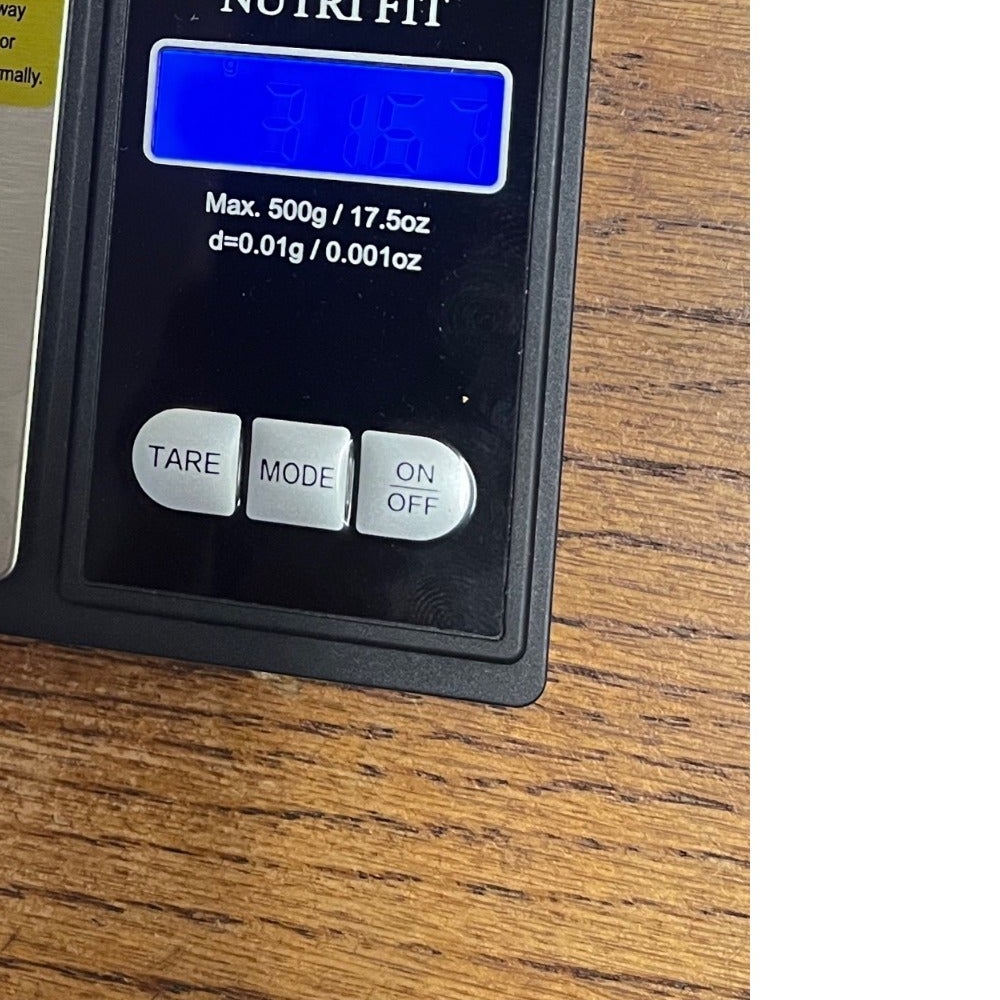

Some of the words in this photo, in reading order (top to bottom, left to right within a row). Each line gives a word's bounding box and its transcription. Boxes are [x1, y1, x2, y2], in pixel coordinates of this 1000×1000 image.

[0, 34, 15, 48] or
[206, 192, 261, 217] Max.
[268, 198, 327, 228] 500g
[351, 206, 430, 234] 17.5oz
[208, 231, 304, 264] d=0.01g
[325, 239, 423, 271] 0.001oz
[149, 445, 221, 475] TARE
[261, 459, 334, 489] MODE
[396, 462, 435, 484] ON
[388, 493, 439, 516] OFF
